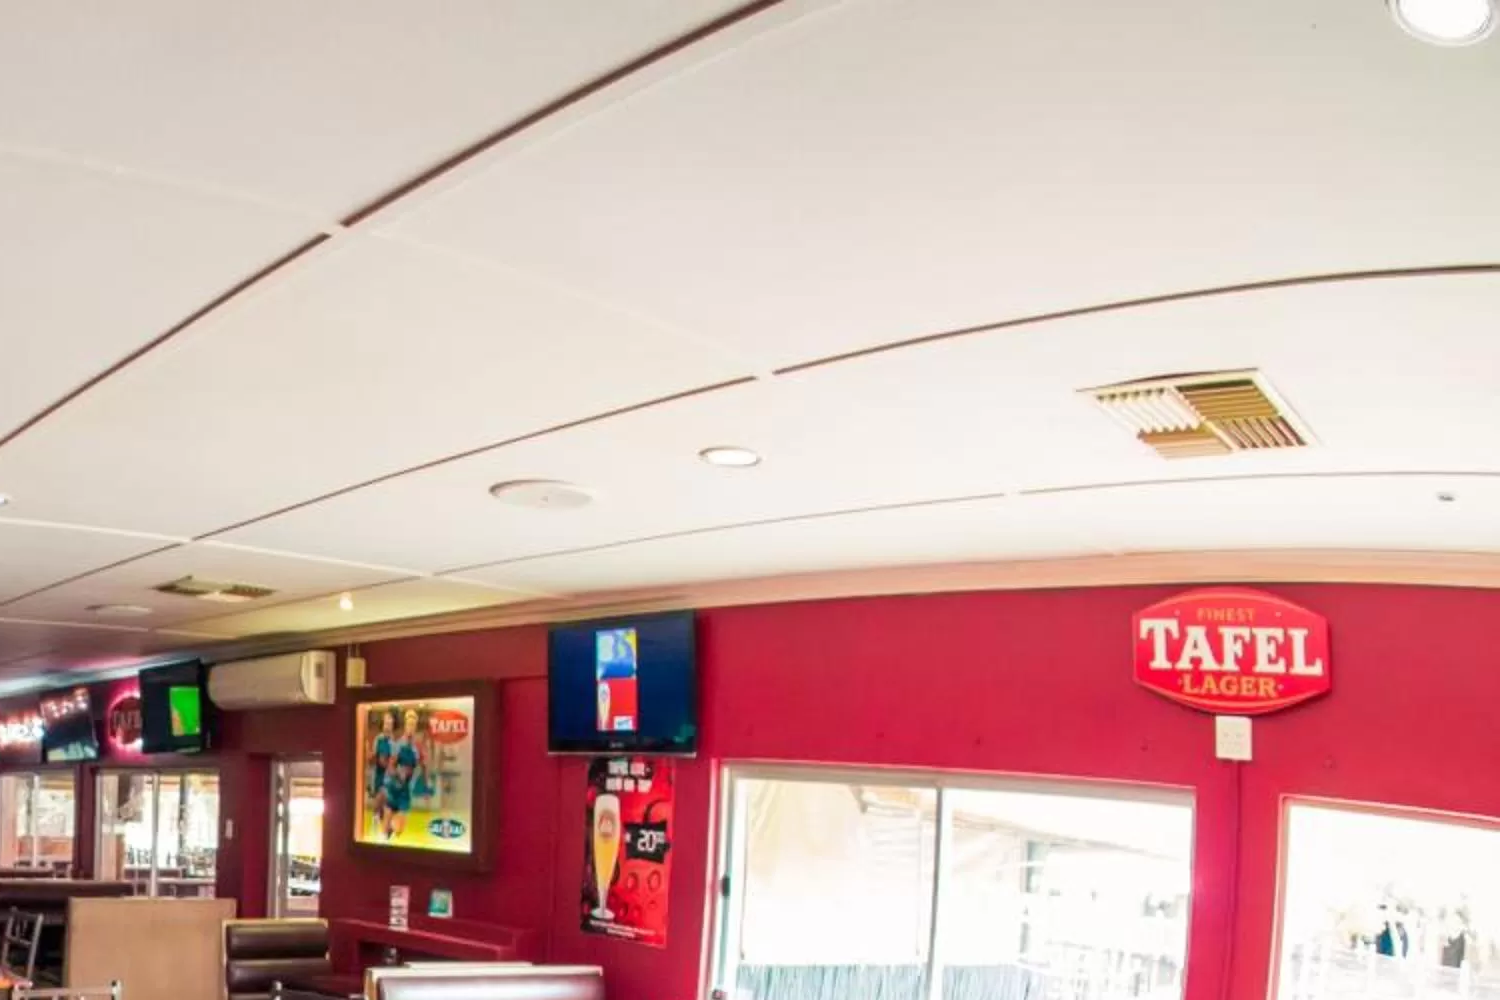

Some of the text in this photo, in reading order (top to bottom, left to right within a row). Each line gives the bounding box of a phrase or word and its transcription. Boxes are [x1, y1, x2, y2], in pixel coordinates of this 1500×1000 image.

[1197, 607, 1255, 621] FINEST
[1140, 618, 1323, 676] TAFEL
[1182, 675, 1277, 697] LAGER
[429, 717, 467, 733] TAFEL
